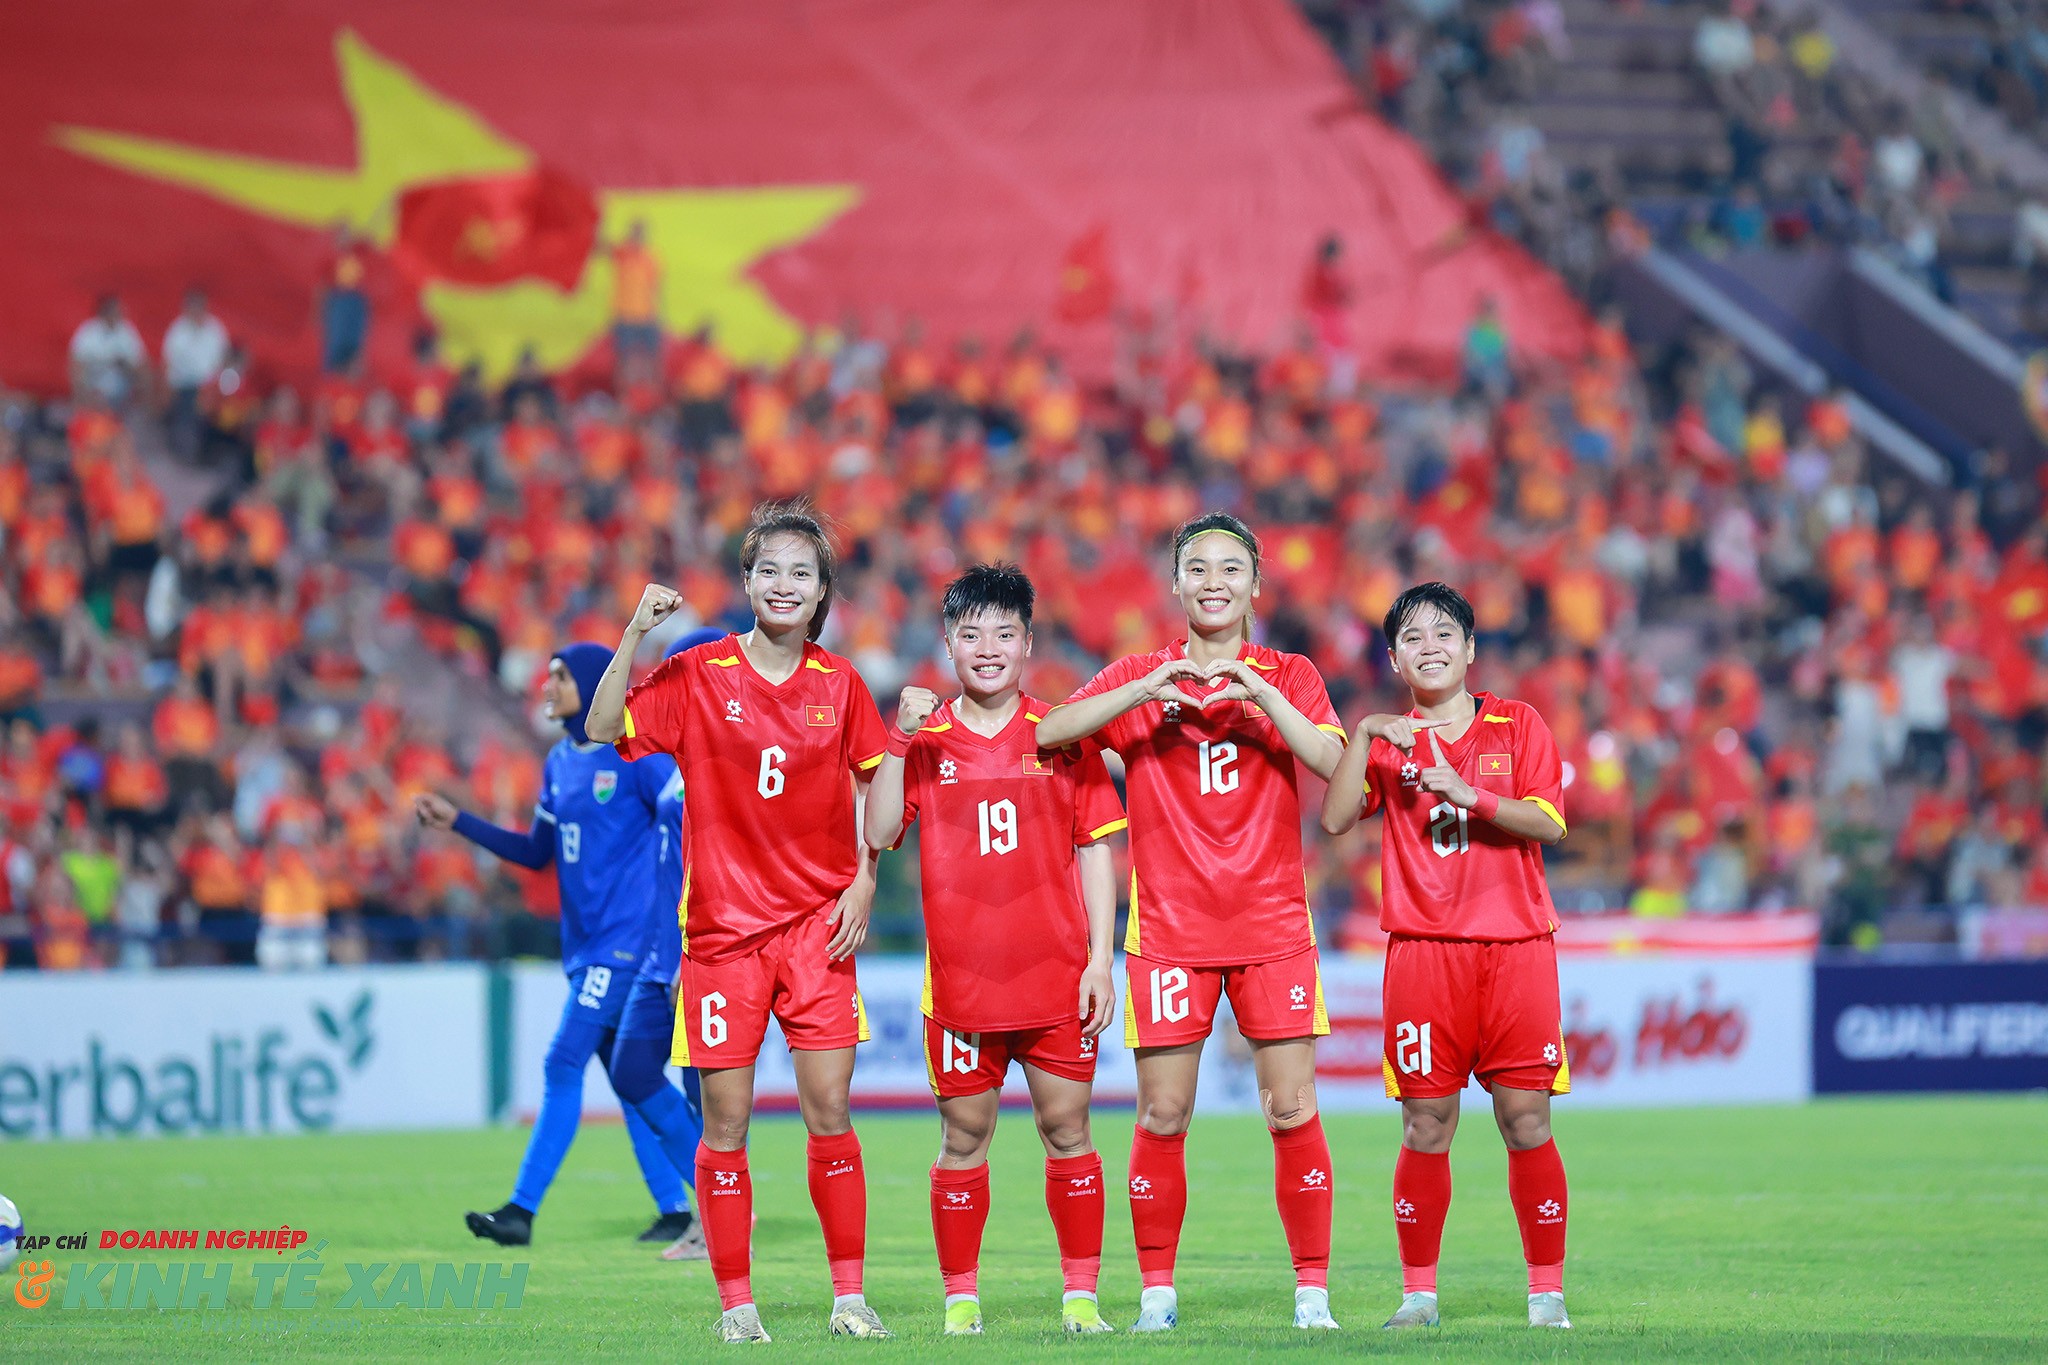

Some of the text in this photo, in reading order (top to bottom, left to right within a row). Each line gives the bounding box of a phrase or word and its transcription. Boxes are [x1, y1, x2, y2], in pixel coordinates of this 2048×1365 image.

[757, 745, 787, 800] 6
[1199, 740, 1239, 796] 12
[559, 822, 581, 863] 19
[978, 798, 1018, 857] 19
[1429, 801, 1470, 858] 21
[582, 965, 612, 998] 19
[1150, 966, 1190, 1024] 12
[701, 991, 727, 1048] 6
[943, 1028, 981, 1075] 19
[1396, 1020, 1432, 1076] 21
[0, 1029, 340, 1134] erbalife
